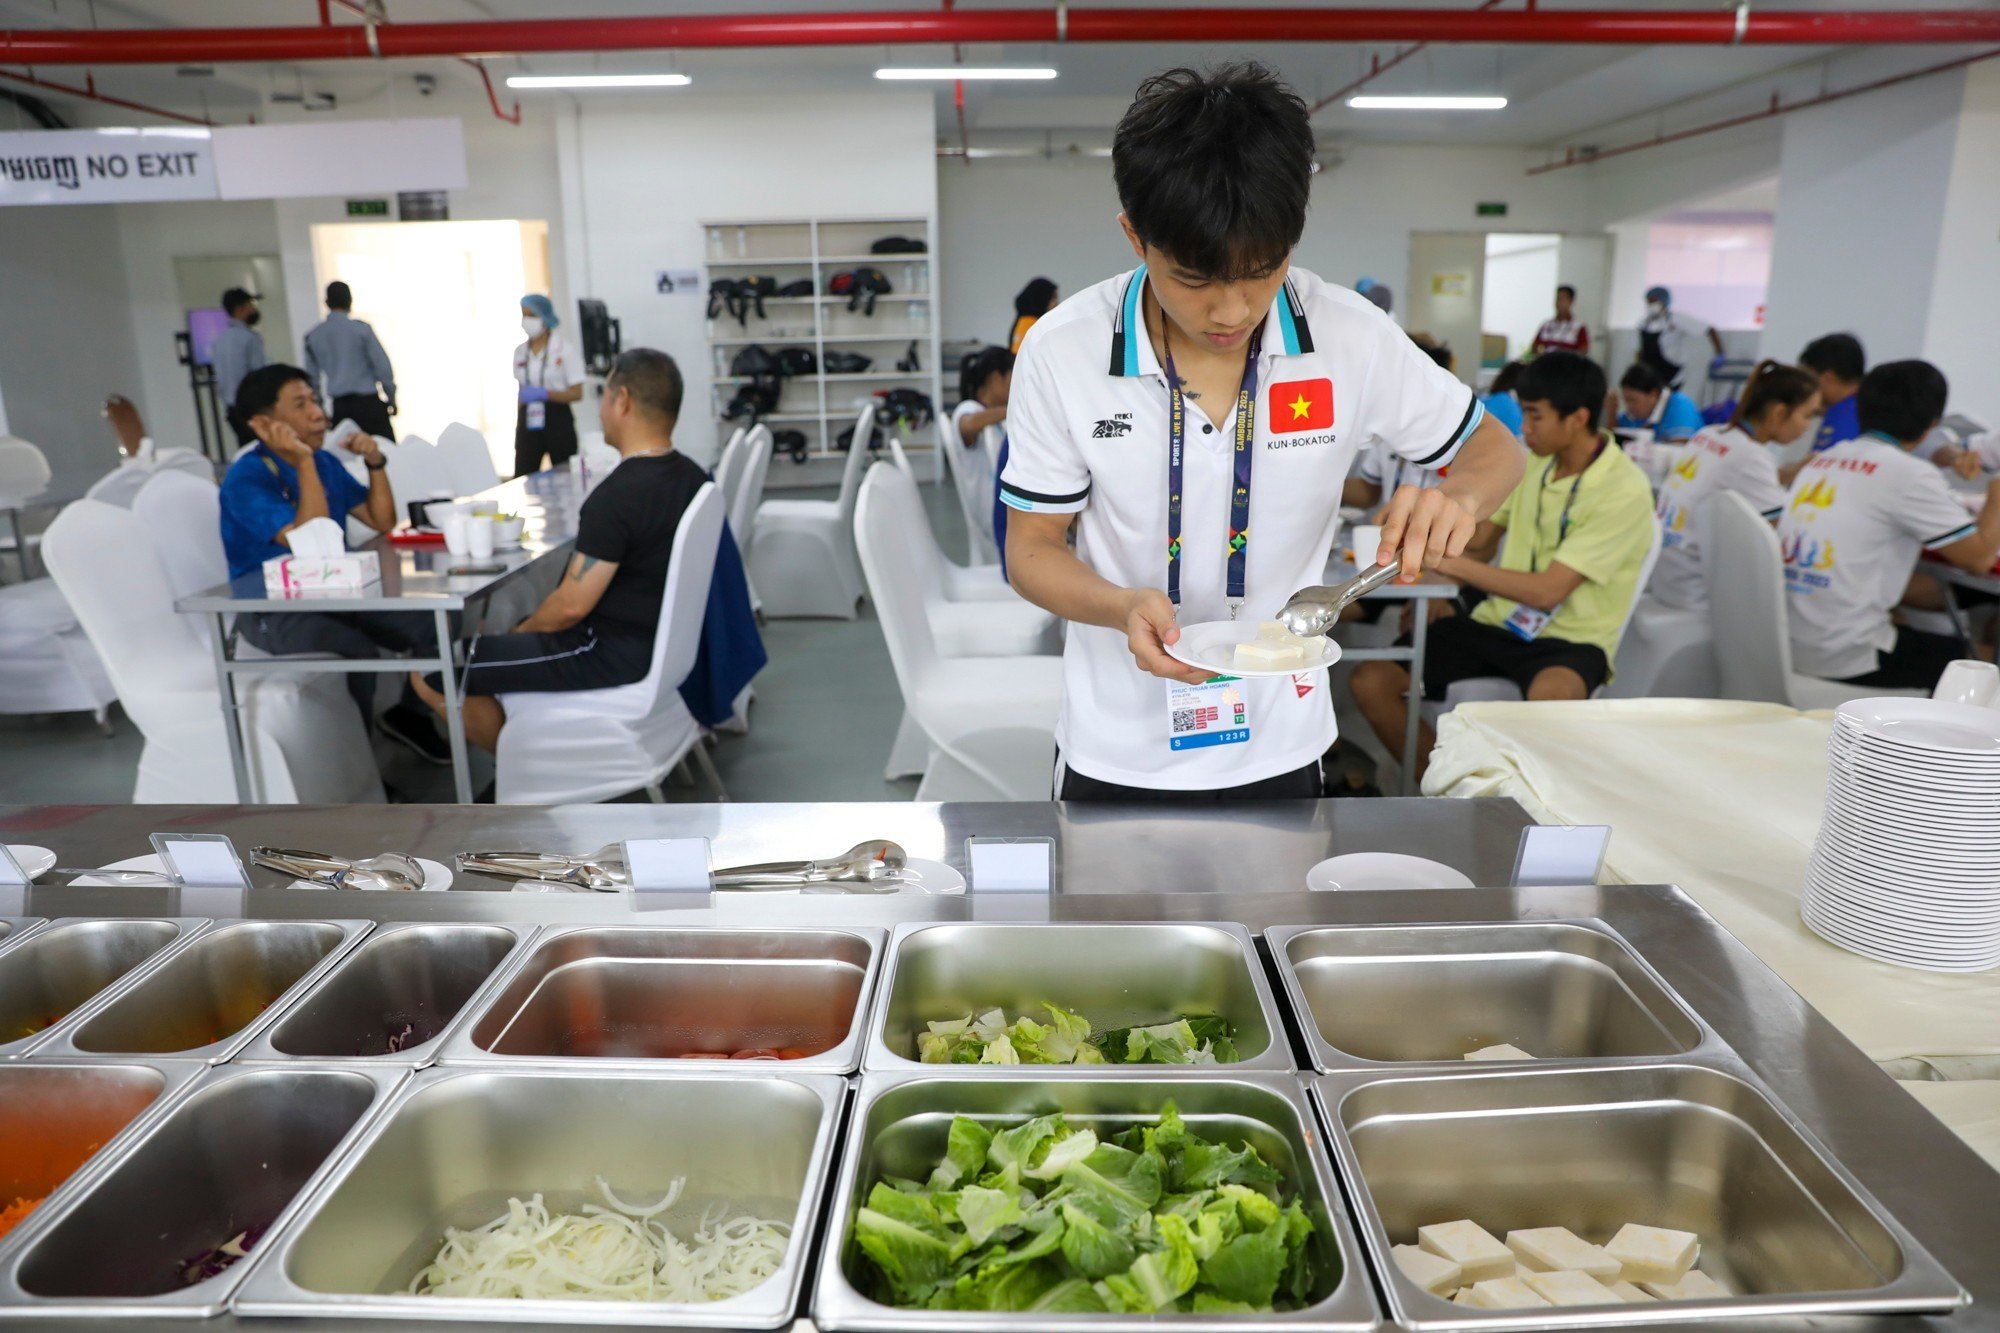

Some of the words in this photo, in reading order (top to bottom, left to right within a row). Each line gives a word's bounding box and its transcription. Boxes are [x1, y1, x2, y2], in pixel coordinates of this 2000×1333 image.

[86, 154, 129, 179] NO
[137, 152, 197, 177] EXIT
[1239, 390, 1249, 409] 2023
[1174, 411, 1181, 420] IN
[1173, 421, 1181, 436] LIVE
[1236, 410, 1247, 451] CAMBODIA
[1267, 435, 1336, 450] KUN-BOKATOR
[1174, 739, 1181, 747] S
